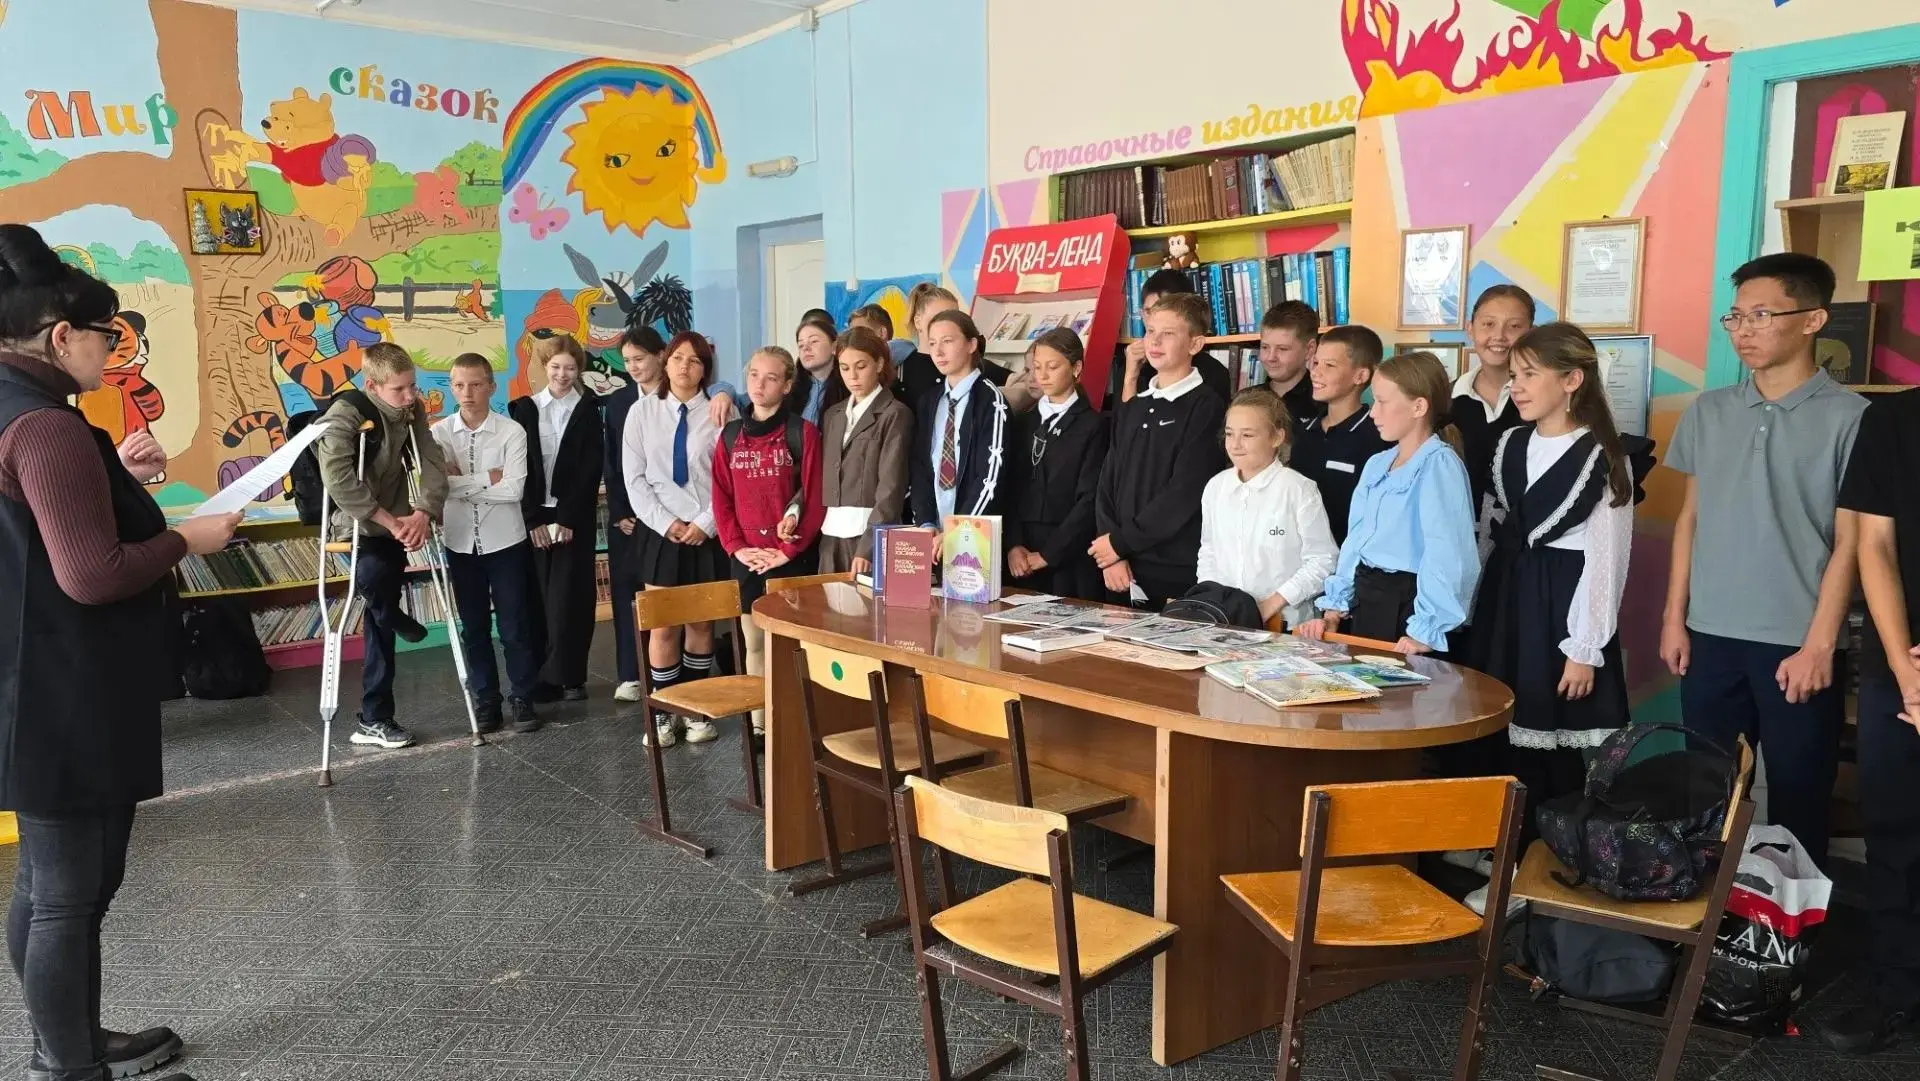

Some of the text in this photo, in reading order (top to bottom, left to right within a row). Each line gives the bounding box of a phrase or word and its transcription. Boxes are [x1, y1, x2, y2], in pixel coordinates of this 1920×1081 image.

[25, 64, 500, 145] Мир сказок
[1023, 94, 1358, 174] Справочные издания
[987, 231, 1104, 275] БУКВА-ЛЕНД
[1268, 525, 1286, 536] alo
